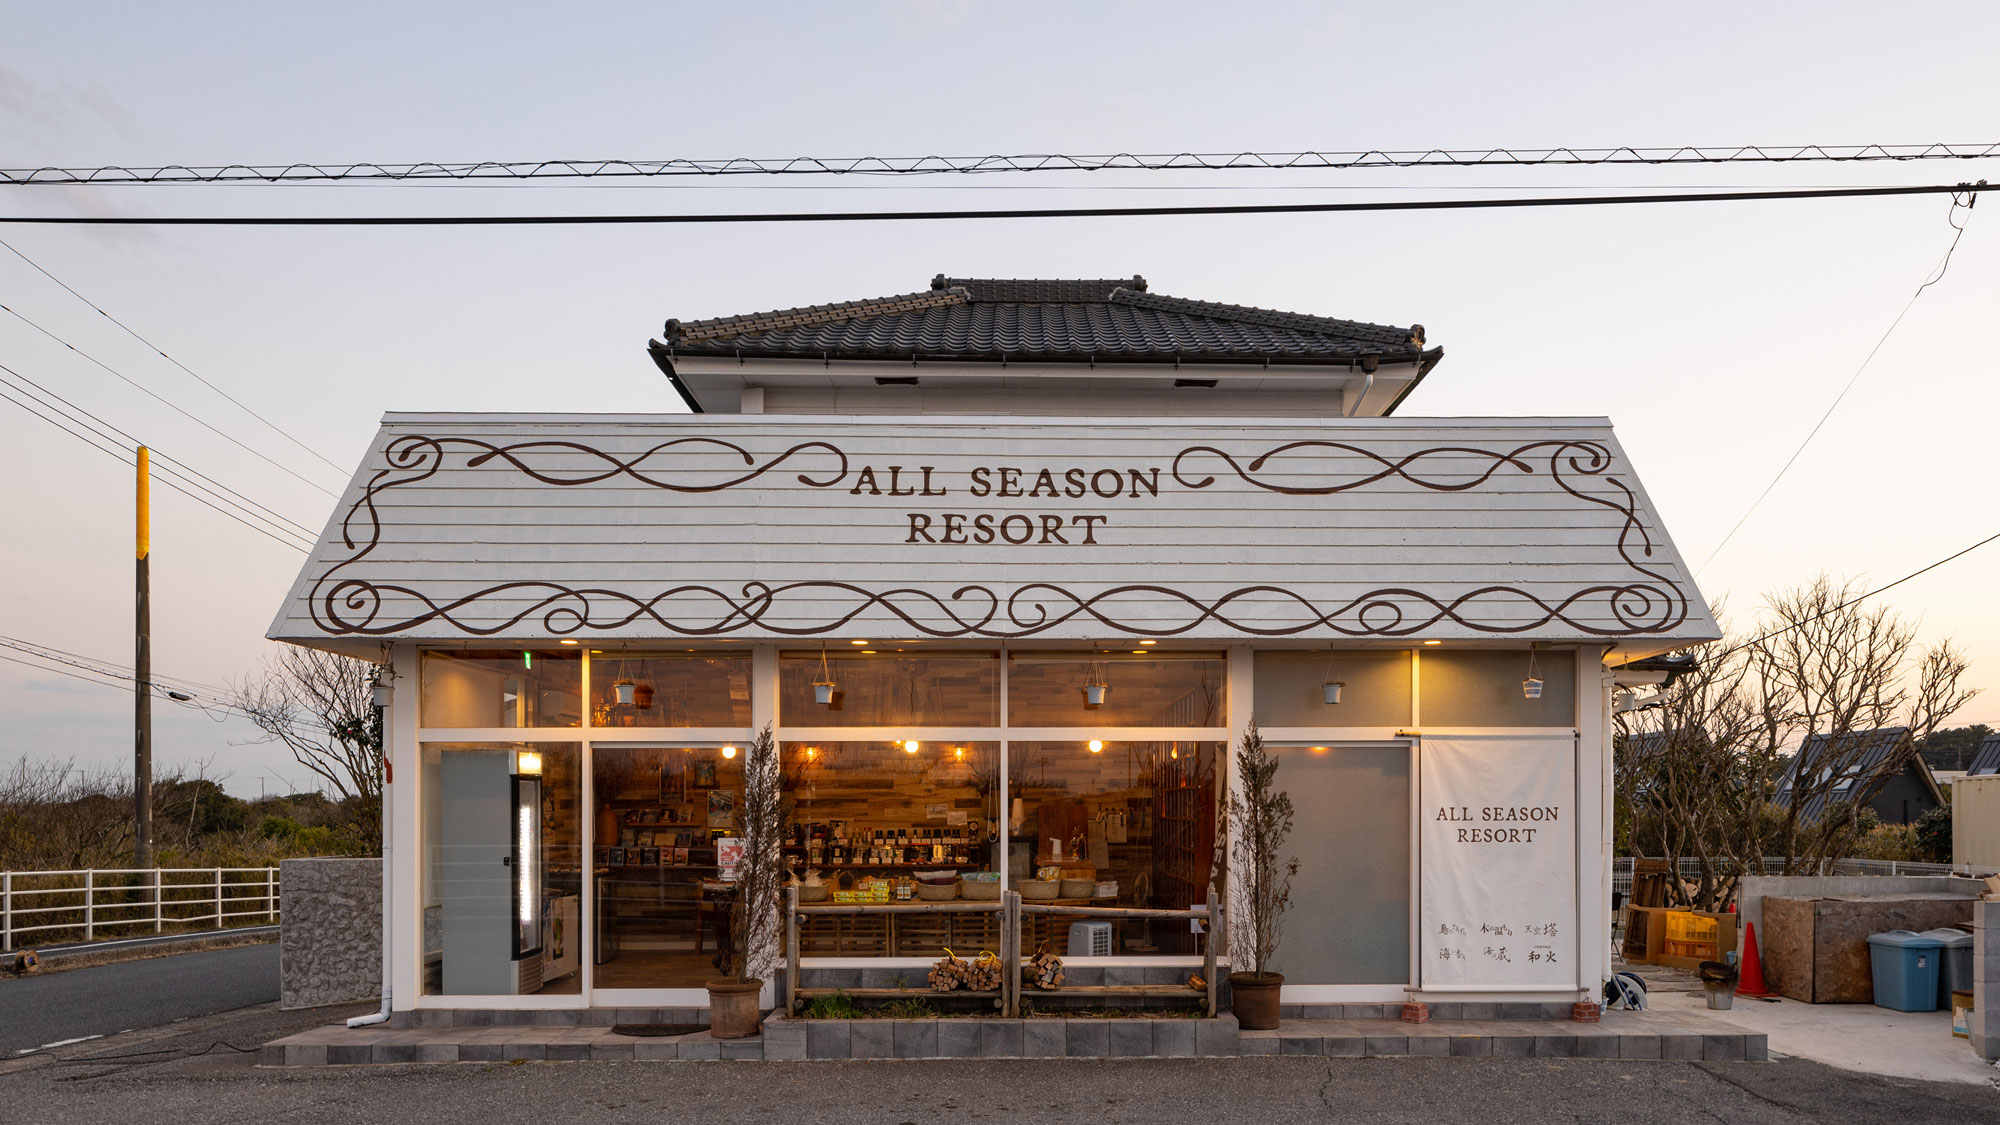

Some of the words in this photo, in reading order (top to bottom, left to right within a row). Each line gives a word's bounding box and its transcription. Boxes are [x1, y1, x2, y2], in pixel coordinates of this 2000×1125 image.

[850, 465, 947, 497] ALL
[970, 466, 1161, 499] SEASON
[905, 513, 1107, 545] RESORT
[1436, 807, 1473, 821] ALL
[1482, 806, 1559, 822] SEASON
[1457, 828, 1537, 843] RESORT
[1527, 950, 1558, 964] 和火
